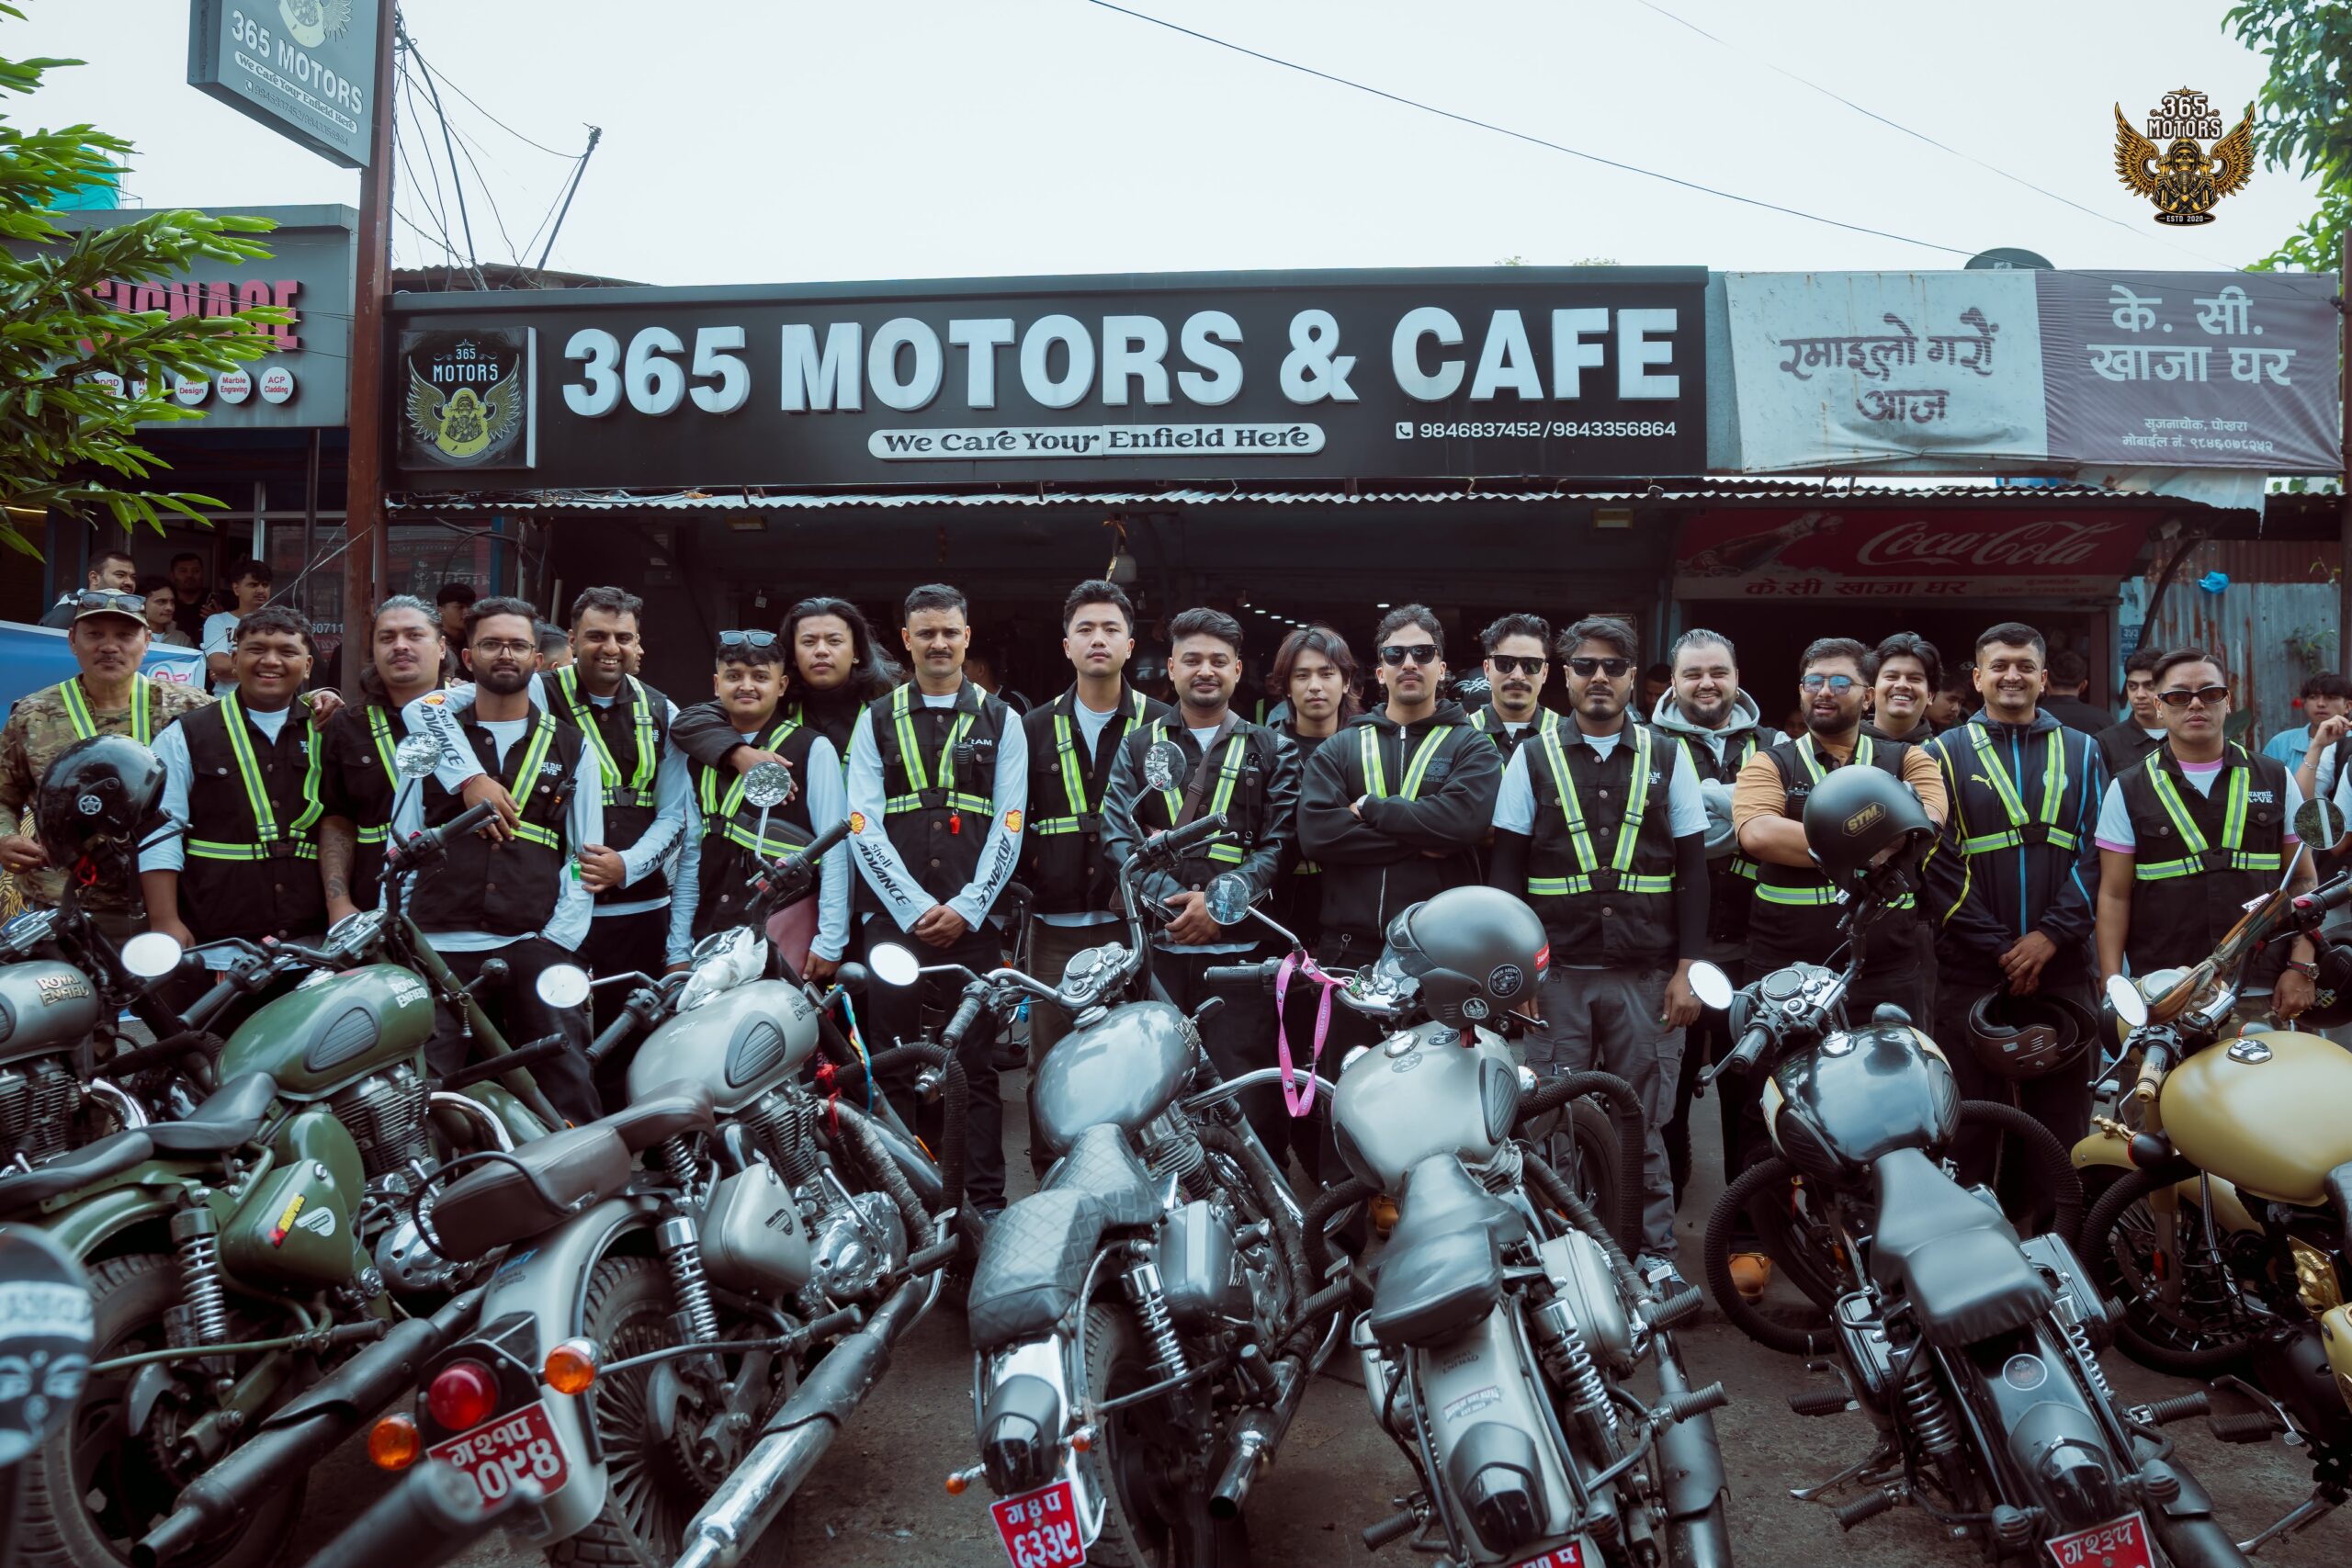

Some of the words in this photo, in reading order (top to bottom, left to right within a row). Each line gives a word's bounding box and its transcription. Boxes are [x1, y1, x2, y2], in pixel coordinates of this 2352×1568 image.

[231, 9, 272, 59] 365
[278, 39, 365, 116] MOTORS
[238, 54, 255, 71] We
[255, 64, 280, 85] Care
[279, 79, 302, 100] Your
[302, 94, 334, 118] Enfield
[334, 112, 356, 130] Here
[456, 348, 476, 360] 365
[562, 324, 752, 419] 365
[780, 309, 1245, 414] MOTORS
[1280, 309, 1361, 404] &
[1391, 306, 1681, 402] CAFE
[2086, 344, 2212, 382] खाजा
[2228, 346, 2296, 386] घर
[267, 376, 286, 384] ACP
[433, 364, 499, 382] MOTORS
[179, 388, 204, 396] Design
[220, 386, 248, 394] Engraving
[264, 386, 288, 394] Cladding
[1856, 389, 1950, 423] आज
[882, 434, 933, 453] We
[940, 429, 1017, 453] Care
[1022, 430, 1100, 455] Your
[1108, 425, 1226, 449] Enfield
[1234, 425, 1310, 447] Here
[1419, 421, 1678, 440] 9846837452/9843356864
[1856, 520, 2130, 566] Coca-Cola
[1834, 580, 1914, 597] खाजा
[1924, 580, 1973, 596] घर
[419, 704, 465, 766] ADVANCE
[1848, 804, 1878, 831] STM
[869, 843, 893, 868] Shell
[856, 840, 911, 907] ADVANCE
[976, 831, 1012, 912] ADVANCE
[36, 974, 81, 990] ROYAL
[40, 986, 90, 1007] ENFIELD
[395, 987, 428, 1009] ENFIELD
[462, 1438, 560, 1505] ०५४
